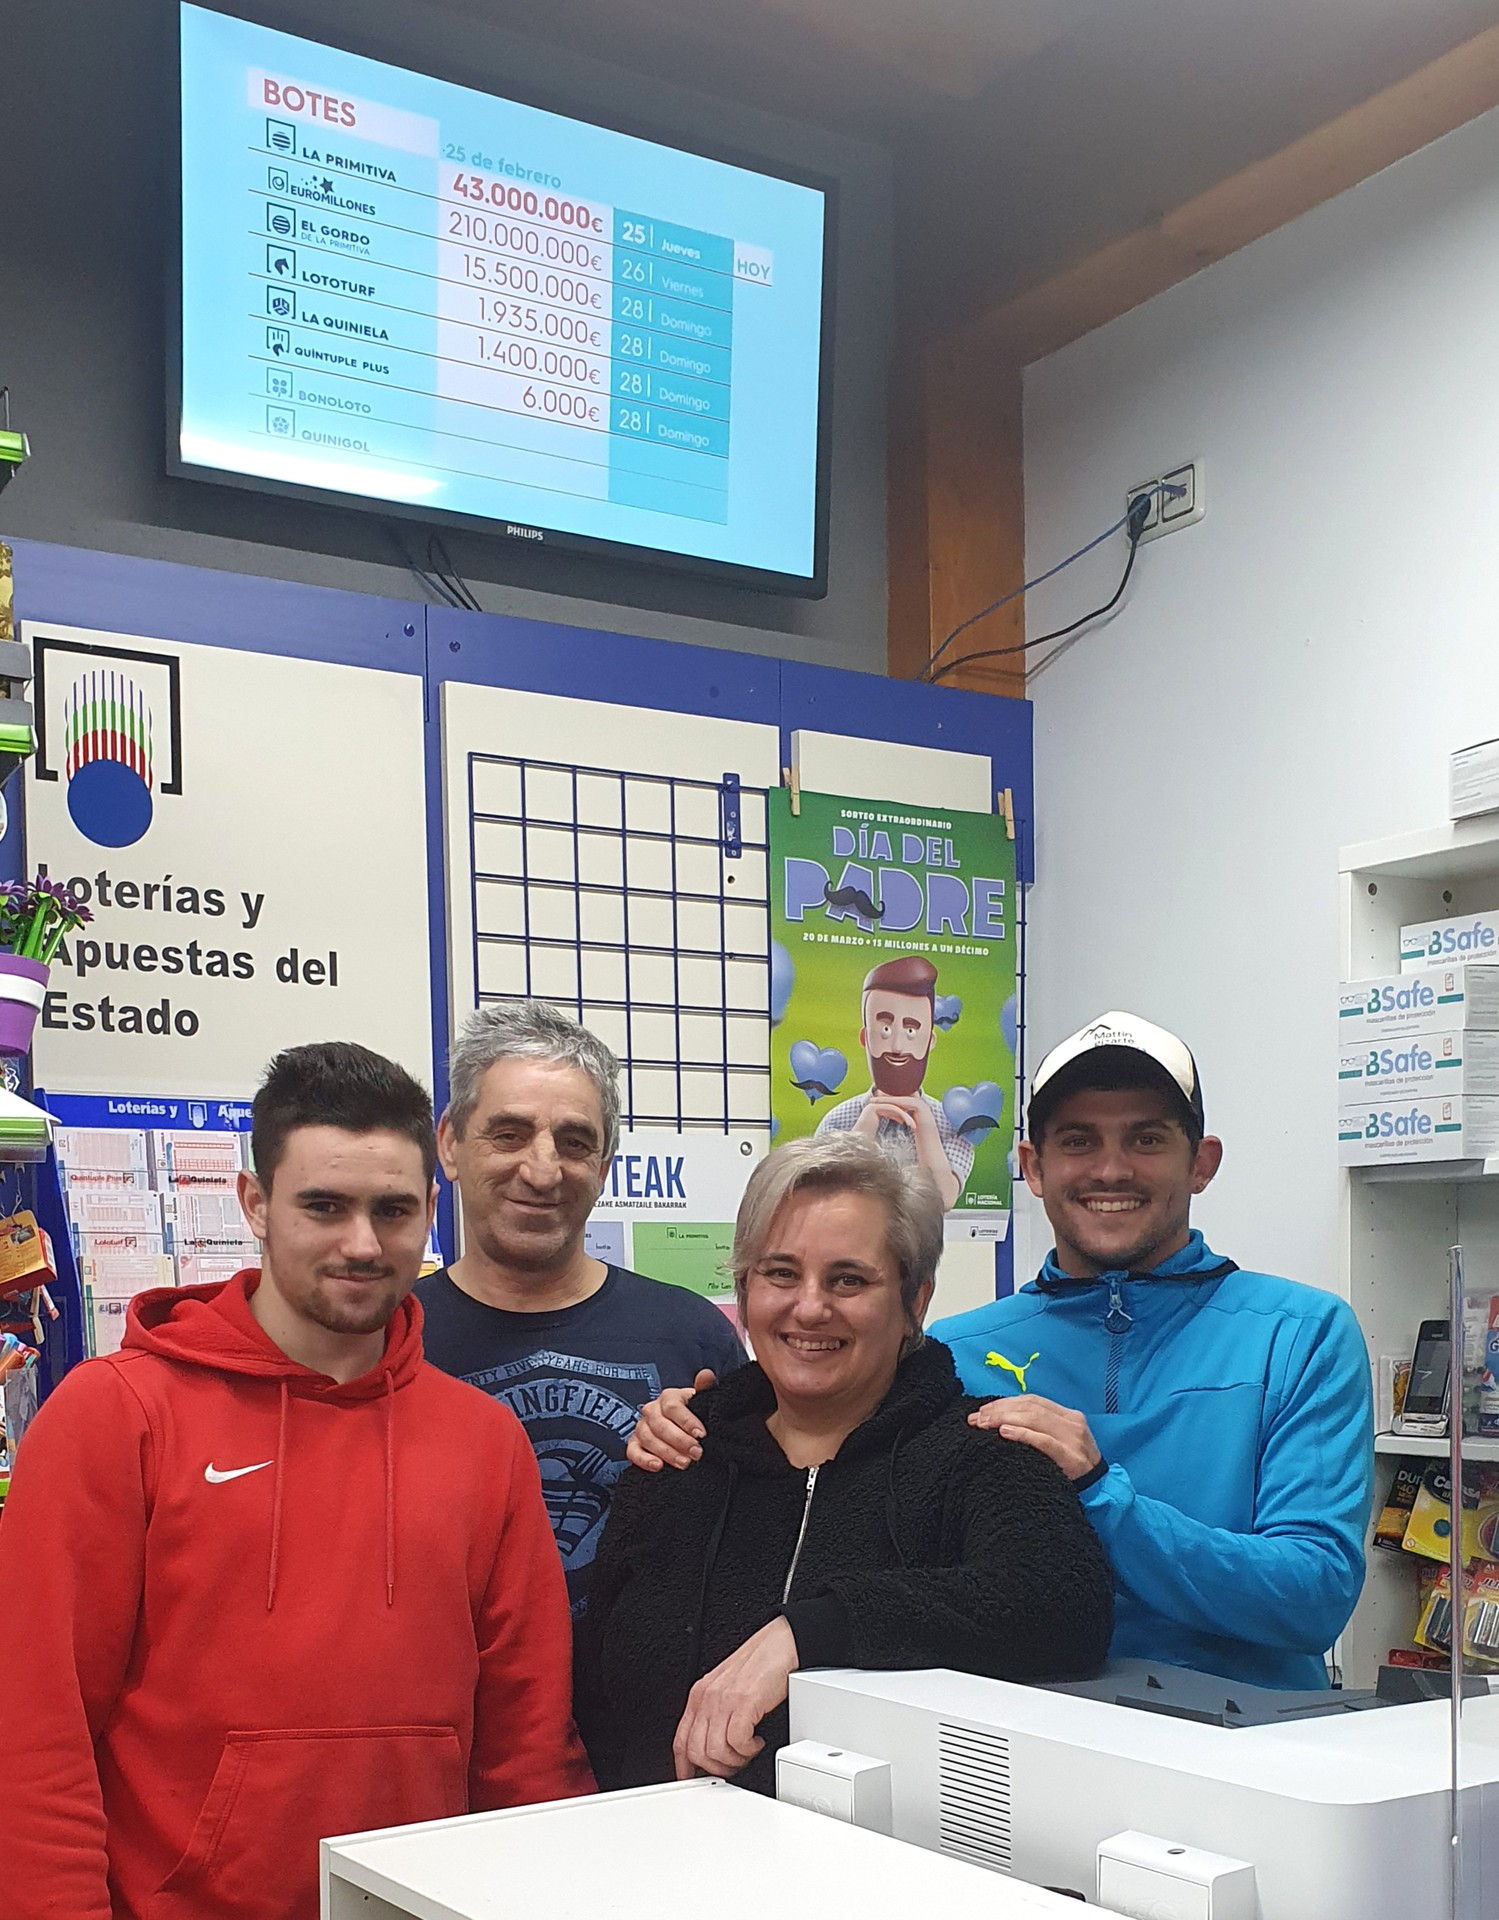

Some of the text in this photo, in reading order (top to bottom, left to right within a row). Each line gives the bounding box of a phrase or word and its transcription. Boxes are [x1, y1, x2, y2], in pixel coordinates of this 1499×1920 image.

[264, 79, 356, 127] BOTES
[446, 143, 561, 188] 25 de febrero
[303, 147, 770, 280] LA PRIMITIVA 43.000.000€ 25 Jueves HOY
[290, 185, 703, 298] EUROMILLONES 210.000.000€ 26 Viernes
[301, 232, 371, 256] DE LA PRIMITIVA
[301, 221, 711, 337] EL GORDO 15.500.000€ 28 Domingo
[302, 271, 711, 374] LOTOTURF 1.935.000€ 28 Domingo
[302, 312, 710, 411] LA QUINIELA 1.400.000€ 28 Domingo
[299, 391, 371, 413] BONOLOTO
[363, 361, 389, 374] PLUS
[523, 386, 599, 422] 6.000€
[619, 409, 641, 431] 28
[658, 425, 709, 447] Domingo
[302, 430, 370, 452] QUINIGOL
[507, 525, 543, 540] PHILIPS
[841, 810, 952, 830] SORTEO EXTRAORDINARIO
[833, 823, 960, 868] DÍA DEL
[241, 891, 265, 929] y
[784, 857, 1005, 940] PADRE
[803, 933, 989, 956] 20 DE MARZO 15 MILLONES A UN DÉCIMO
[1429, 921, 1495, 955] BSafe
[276, 948, 338, 986] del
[42, 991, 199, 1036] Estado
[1368, 980, 1434, 1014] BSafe
[1094, 1032, 1132, 1040] Mattin
[1366, 1043, 1432, 1076] BSafe
[108, 1101, 166, 1115] Loterías
[169, 1105, 178, 1119] y
[1366, 1108, 1431, 1138] BSafe
[600, 1155, 686, 1198] TEAK
[596, 1365, 618, 1377] FOR
[625, 1368, 650, 1378] THE
[504, 1384, 640, 1439] INGFIELD
